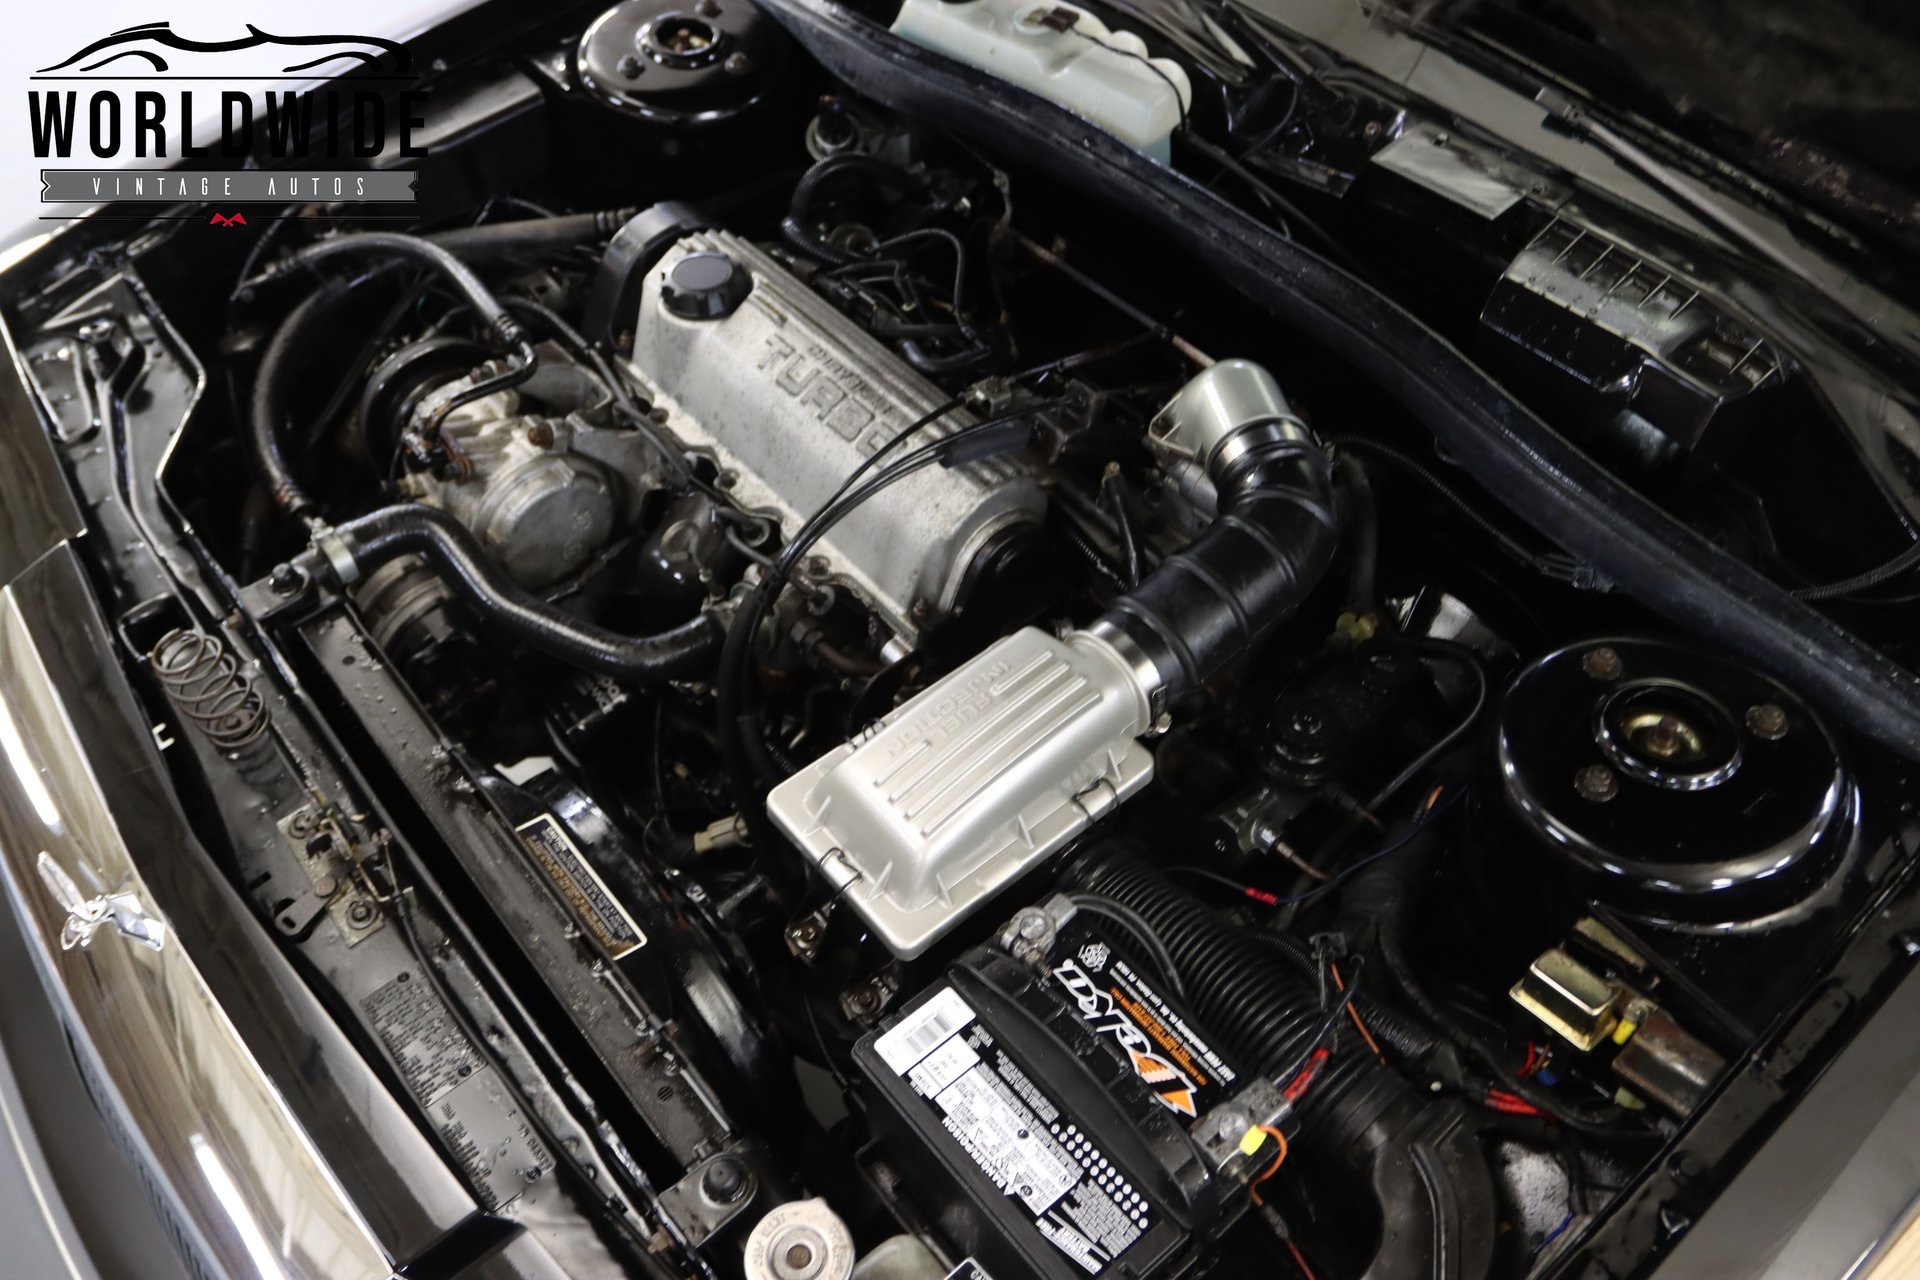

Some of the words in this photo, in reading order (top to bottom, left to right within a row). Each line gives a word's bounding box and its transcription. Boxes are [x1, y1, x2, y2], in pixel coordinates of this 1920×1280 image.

[757, 333, 907, 471] TURBO
[926, 692, 994, 738] FUEL
[1052, 959, 1199, 1119] Deka
[941, 1115, 1006, 1189] DANGER/POISON
